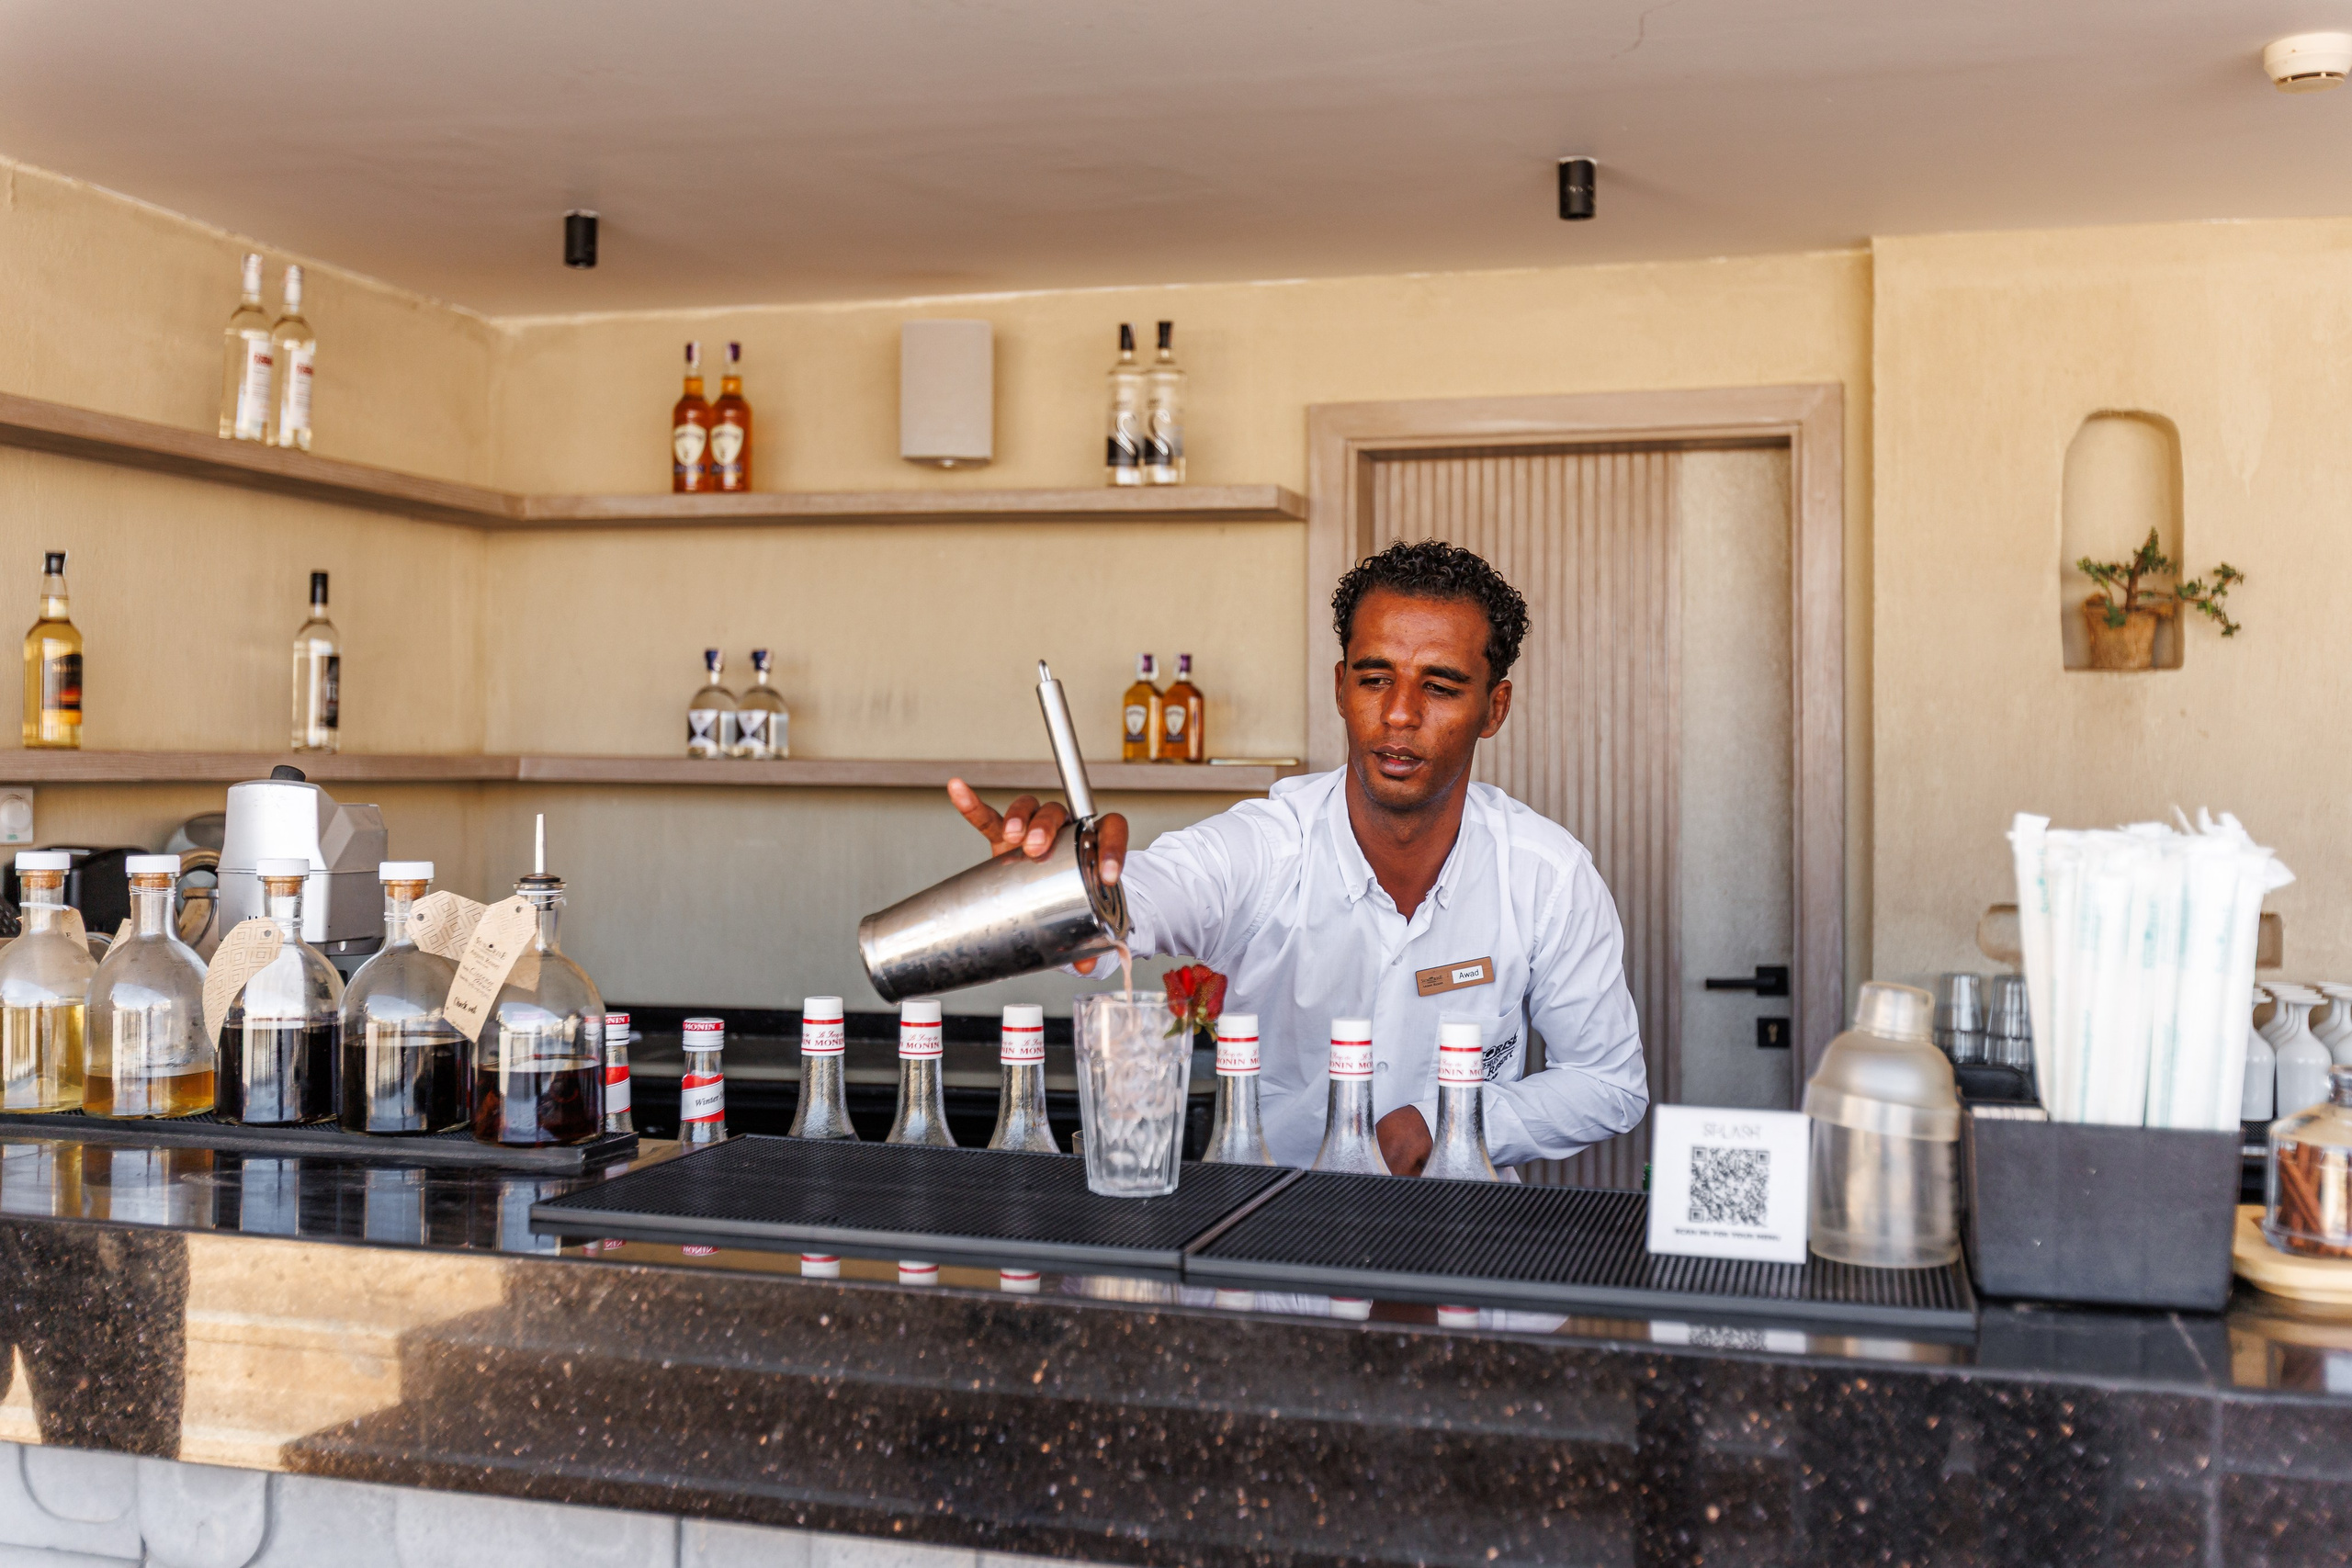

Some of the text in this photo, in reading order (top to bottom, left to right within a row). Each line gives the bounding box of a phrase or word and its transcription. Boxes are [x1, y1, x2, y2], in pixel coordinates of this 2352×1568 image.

[1459, 969, 1479, 979] Awad
[606, 1016, 625, 1024] NIN
[684, 1022, 716, 1031] MONIN
[906, 1041, 939, 1049] MONIN
[695, 1095, 719, 1107] Winter
[1702, 1122, 1762, 1140] SPLASH
